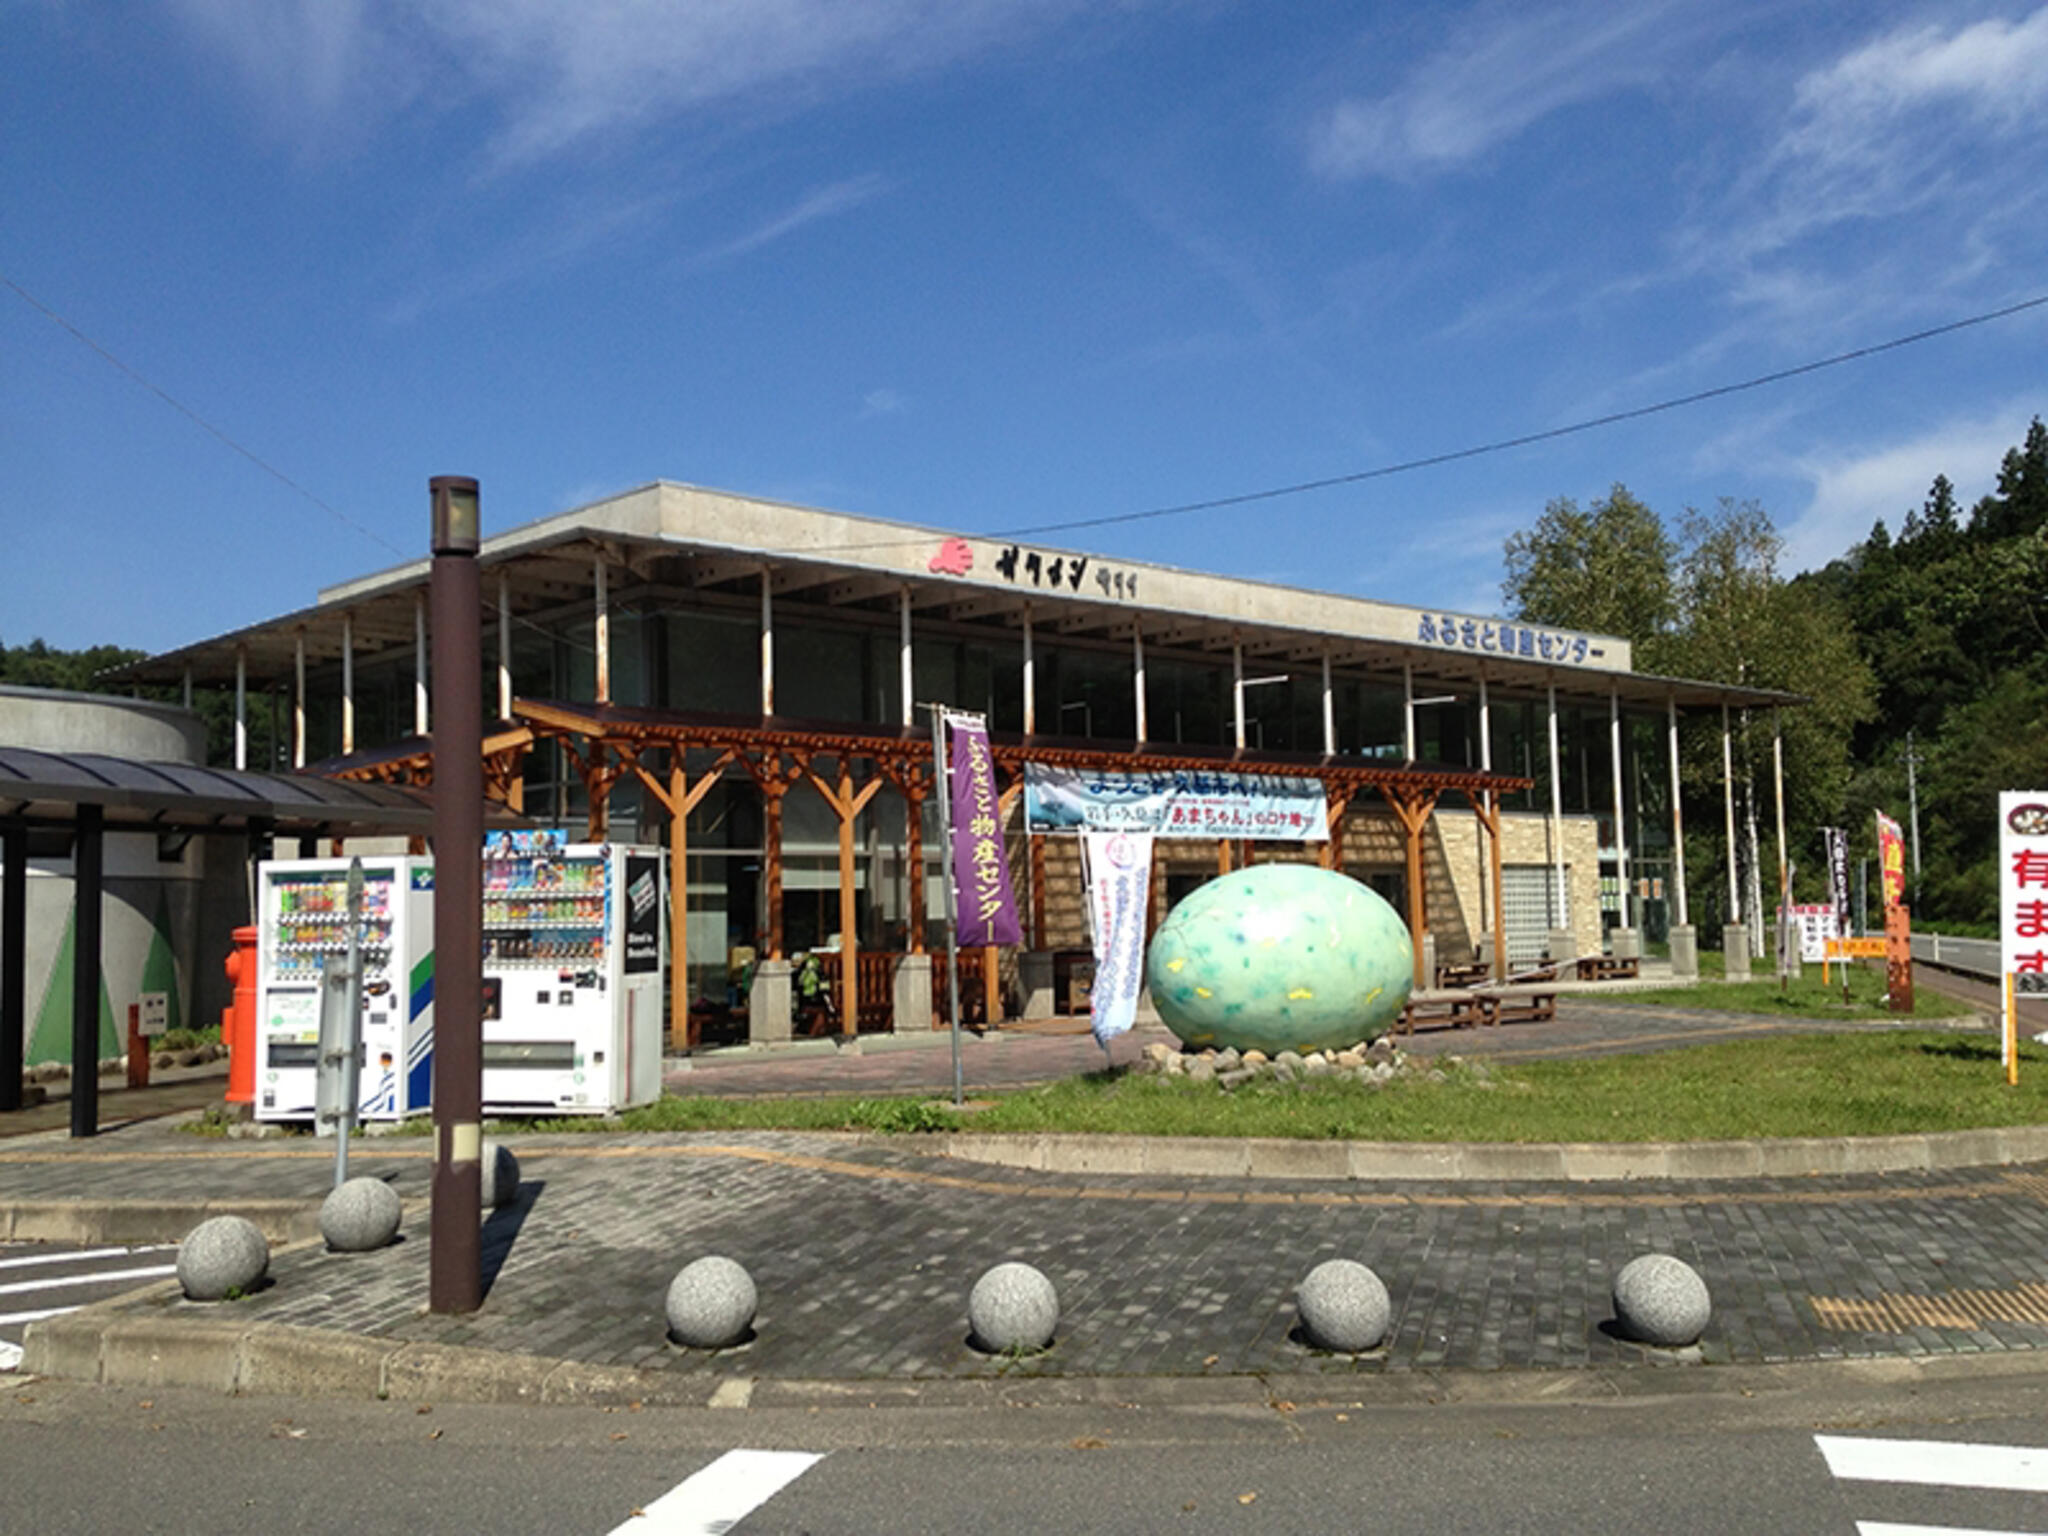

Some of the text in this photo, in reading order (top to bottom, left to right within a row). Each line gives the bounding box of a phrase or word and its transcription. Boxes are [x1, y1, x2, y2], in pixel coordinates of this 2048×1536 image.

[967, 734, 1004, 944] ふるさと物産センター
